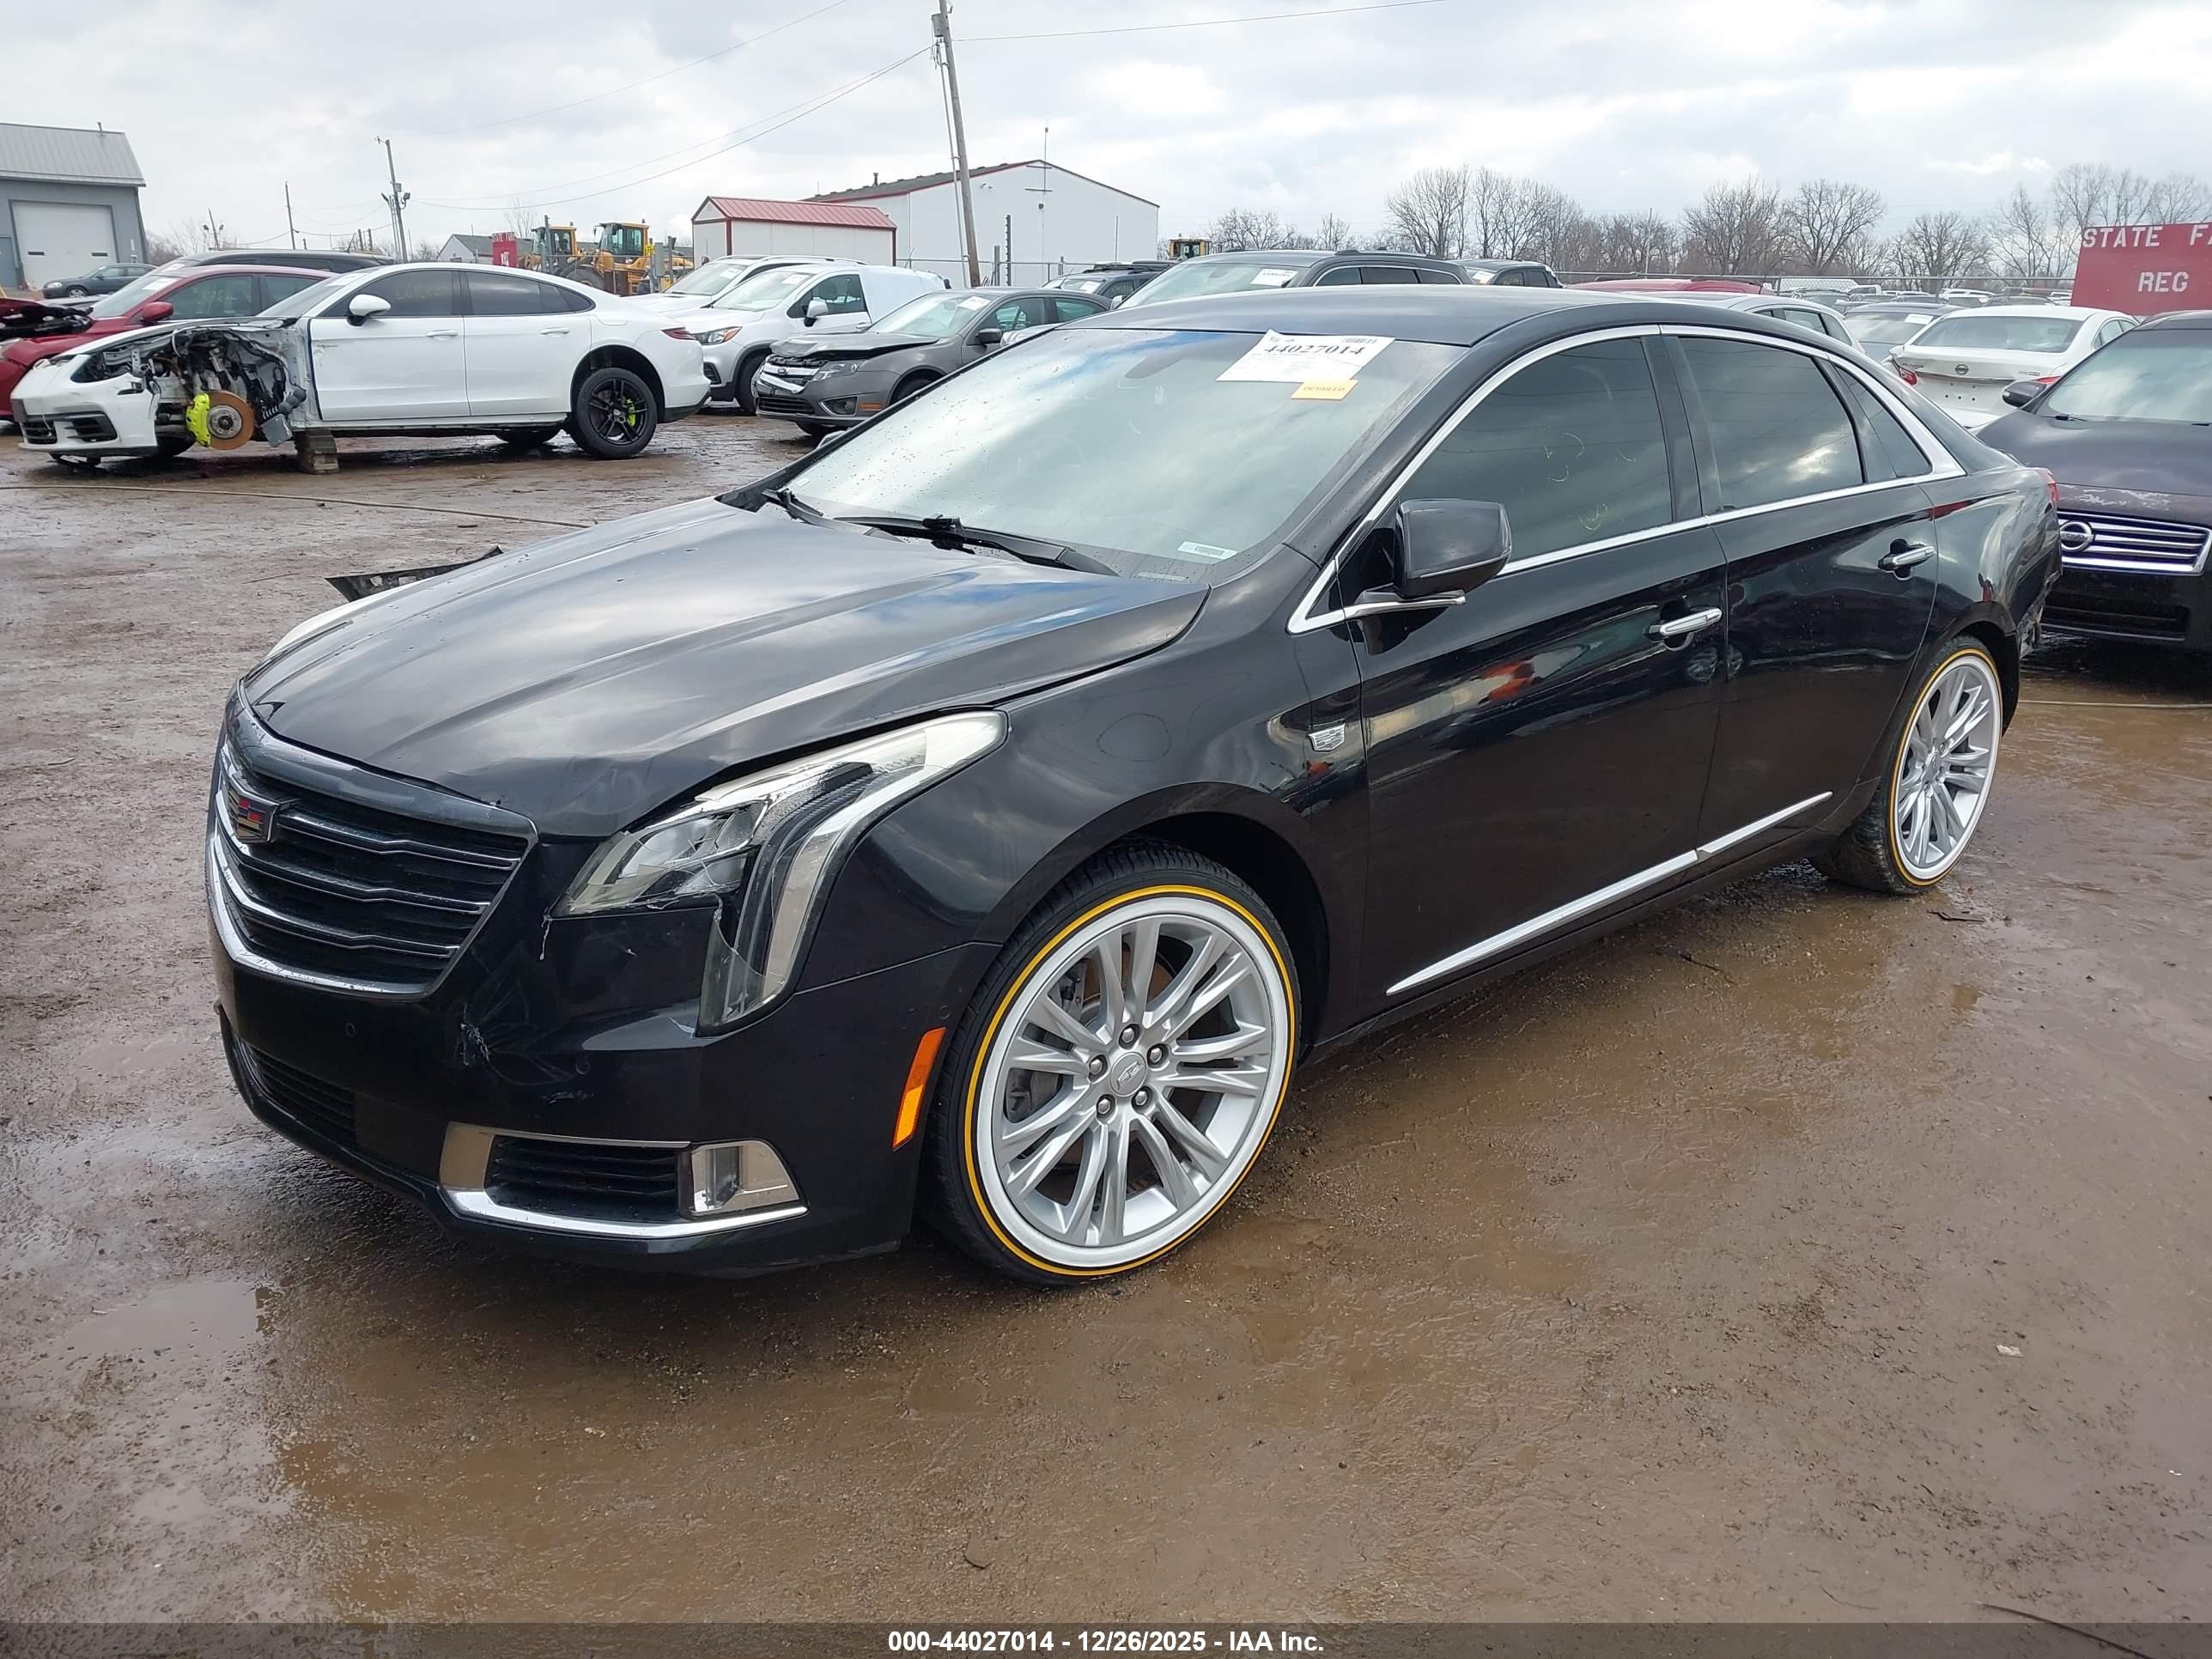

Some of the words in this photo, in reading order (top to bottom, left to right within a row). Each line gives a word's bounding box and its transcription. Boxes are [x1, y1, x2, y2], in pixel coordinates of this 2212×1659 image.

[2082, 226, 2163, 247] STATE
[2137, 271, 2190, 293] REG
[1264, 344, 1366, 356] 44027014
